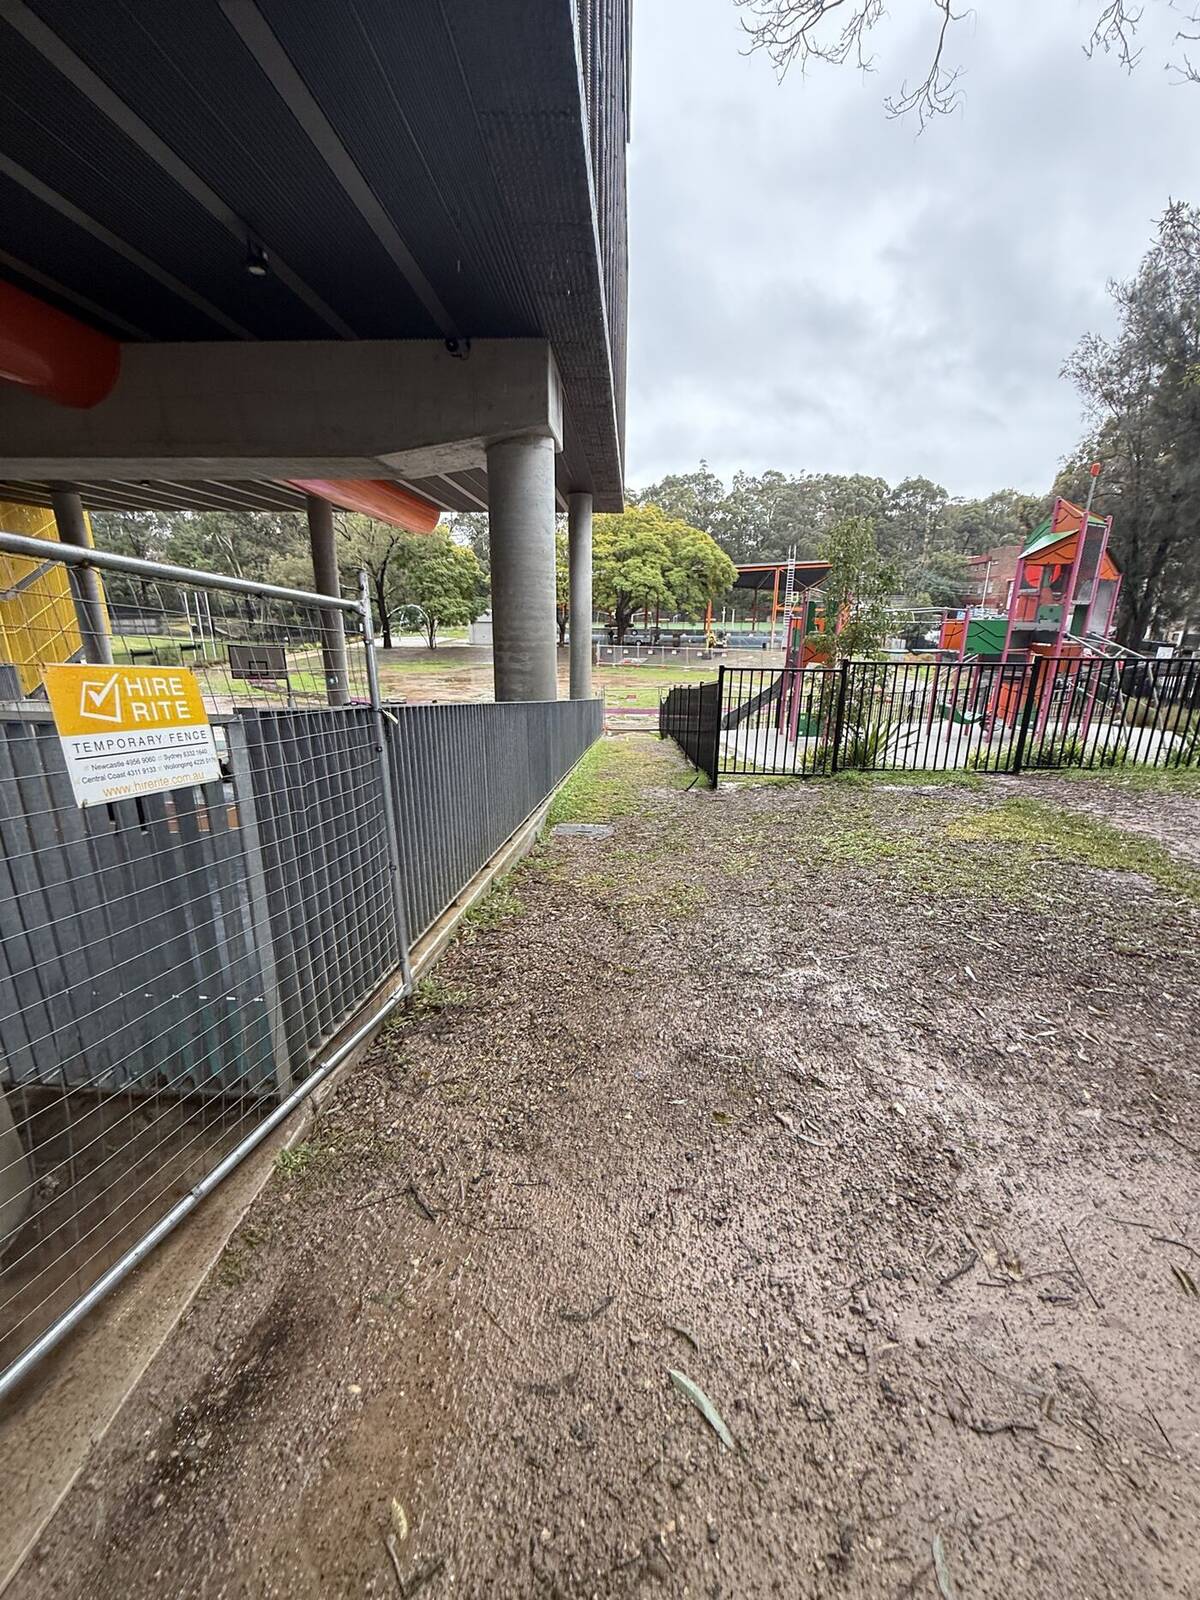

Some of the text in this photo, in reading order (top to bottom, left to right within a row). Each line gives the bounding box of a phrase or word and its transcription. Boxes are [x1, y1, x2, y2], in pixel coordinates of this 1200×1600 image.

[124, 677, 184, 697] HIRE
[130, 700, 191, 722] RITE
[72, 730, 207, 754] TEMPORARY FENCE
[82, 775, 106, 784] Central
[107, 772, 126, 780] Coast
[163, 761, 193, 770] Wollongong
[91, 761, 125, 771] Newcastle
[163, 753, 182, 761] Sydney
